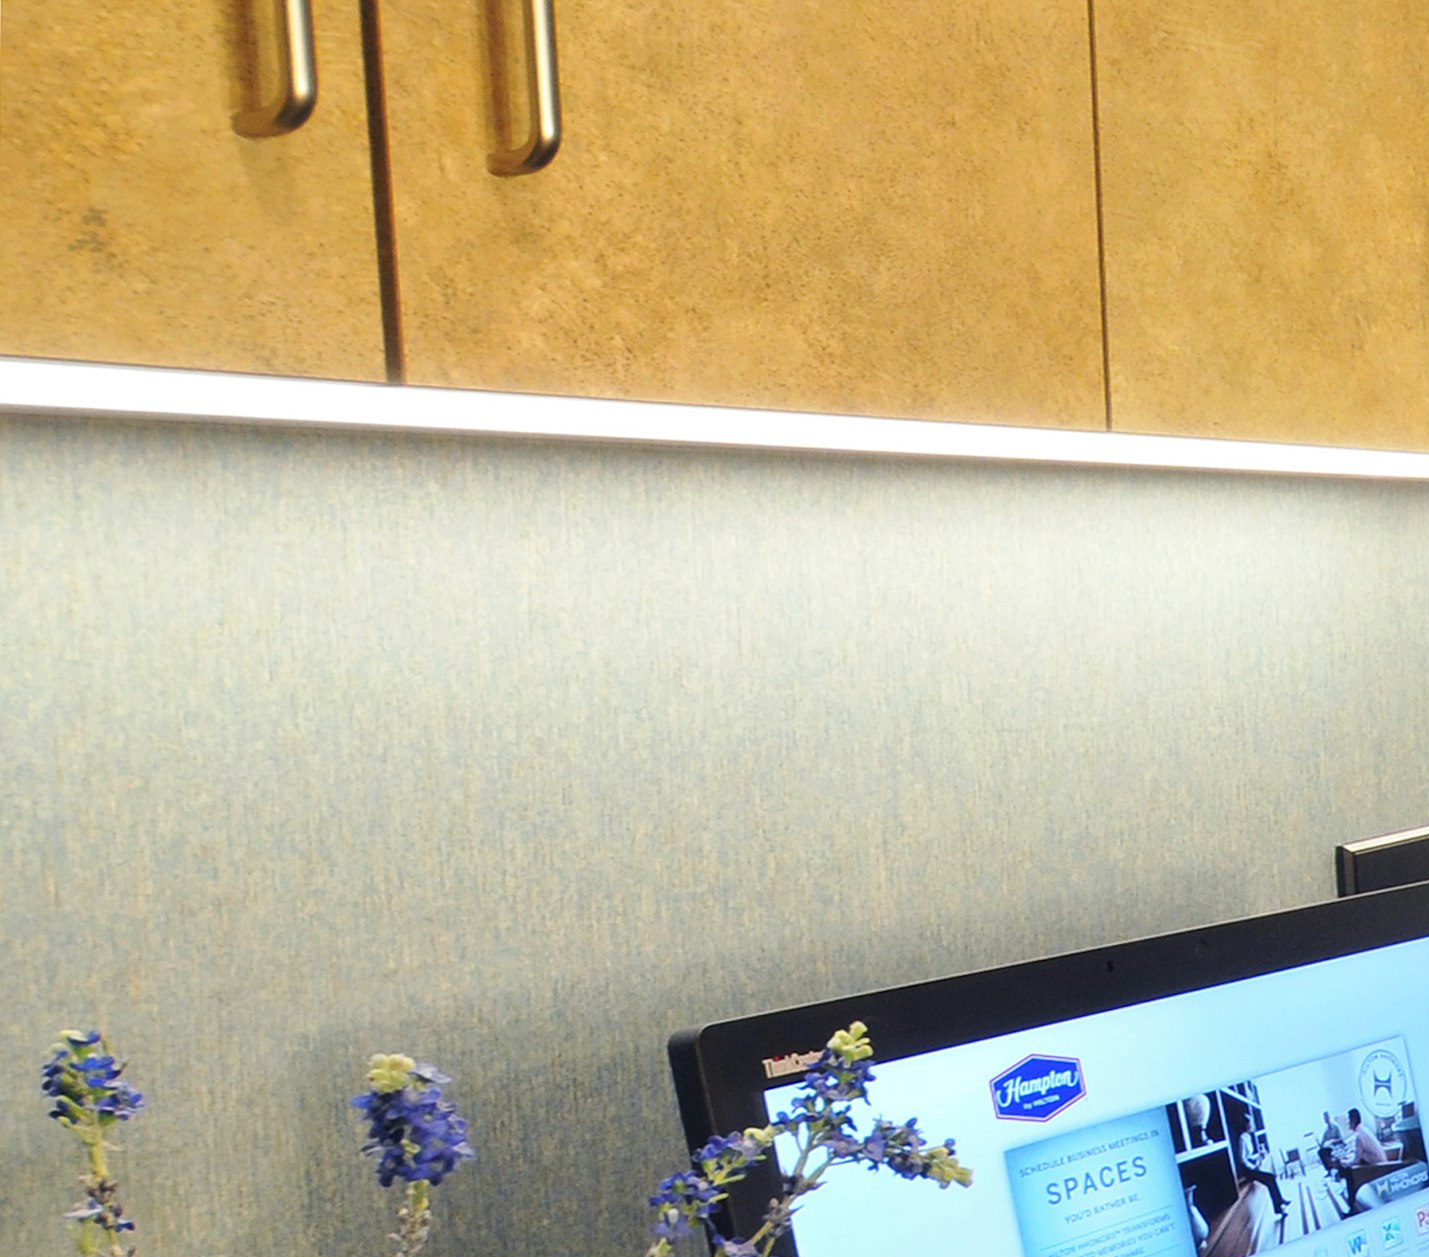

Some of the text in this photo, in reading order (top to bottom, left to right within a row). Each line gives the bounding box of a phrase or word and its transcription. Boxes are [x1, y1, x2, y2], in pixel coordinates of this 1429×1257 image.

[996, 1069, 1080, 1108] Hampton
[1019, 1157, 1065, 1178] SCHEDULE
[1066, 1145, 1107, 1163] BUSINESS
[1108, 1133, 1149, 1151] MEETINGS
[1045, 1156, 1148, 1205] SPACES
[1065, 1209, 1093, 1225] YOU'D
[1093, 1197, 1126, 1214] RATHER
